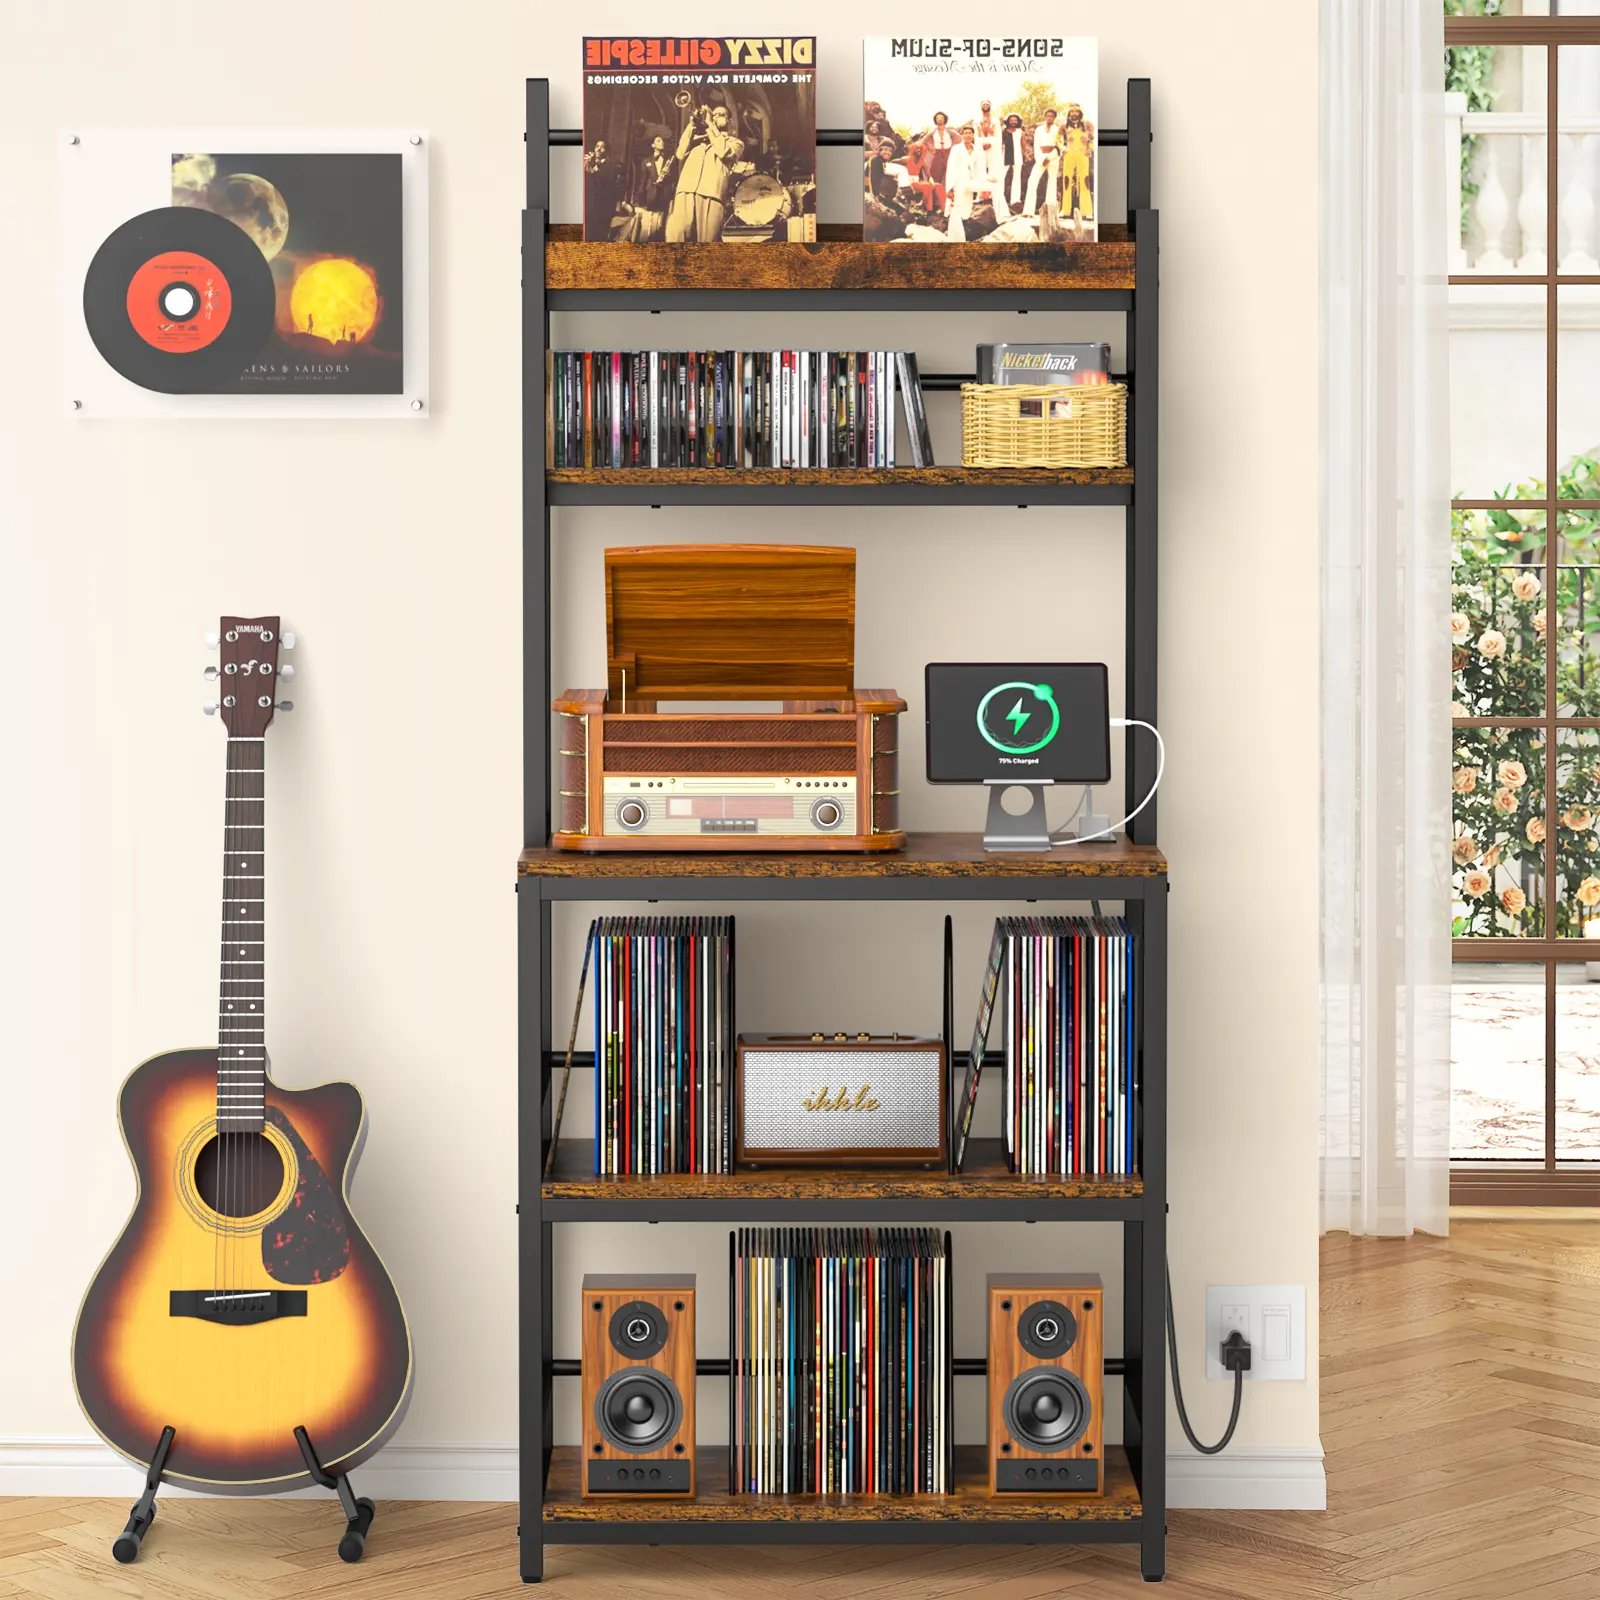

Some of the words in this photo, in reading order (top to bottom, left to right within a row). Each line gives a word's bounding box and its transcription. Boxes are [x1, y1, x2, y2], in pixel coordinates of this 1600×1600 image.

[1001, 353, 1078, 371] Nickelback
[243, 364, 275, 373] ENS
[294, 364, 351, 373] SAILORS
[1013, 757, 1039, 765] Charged
